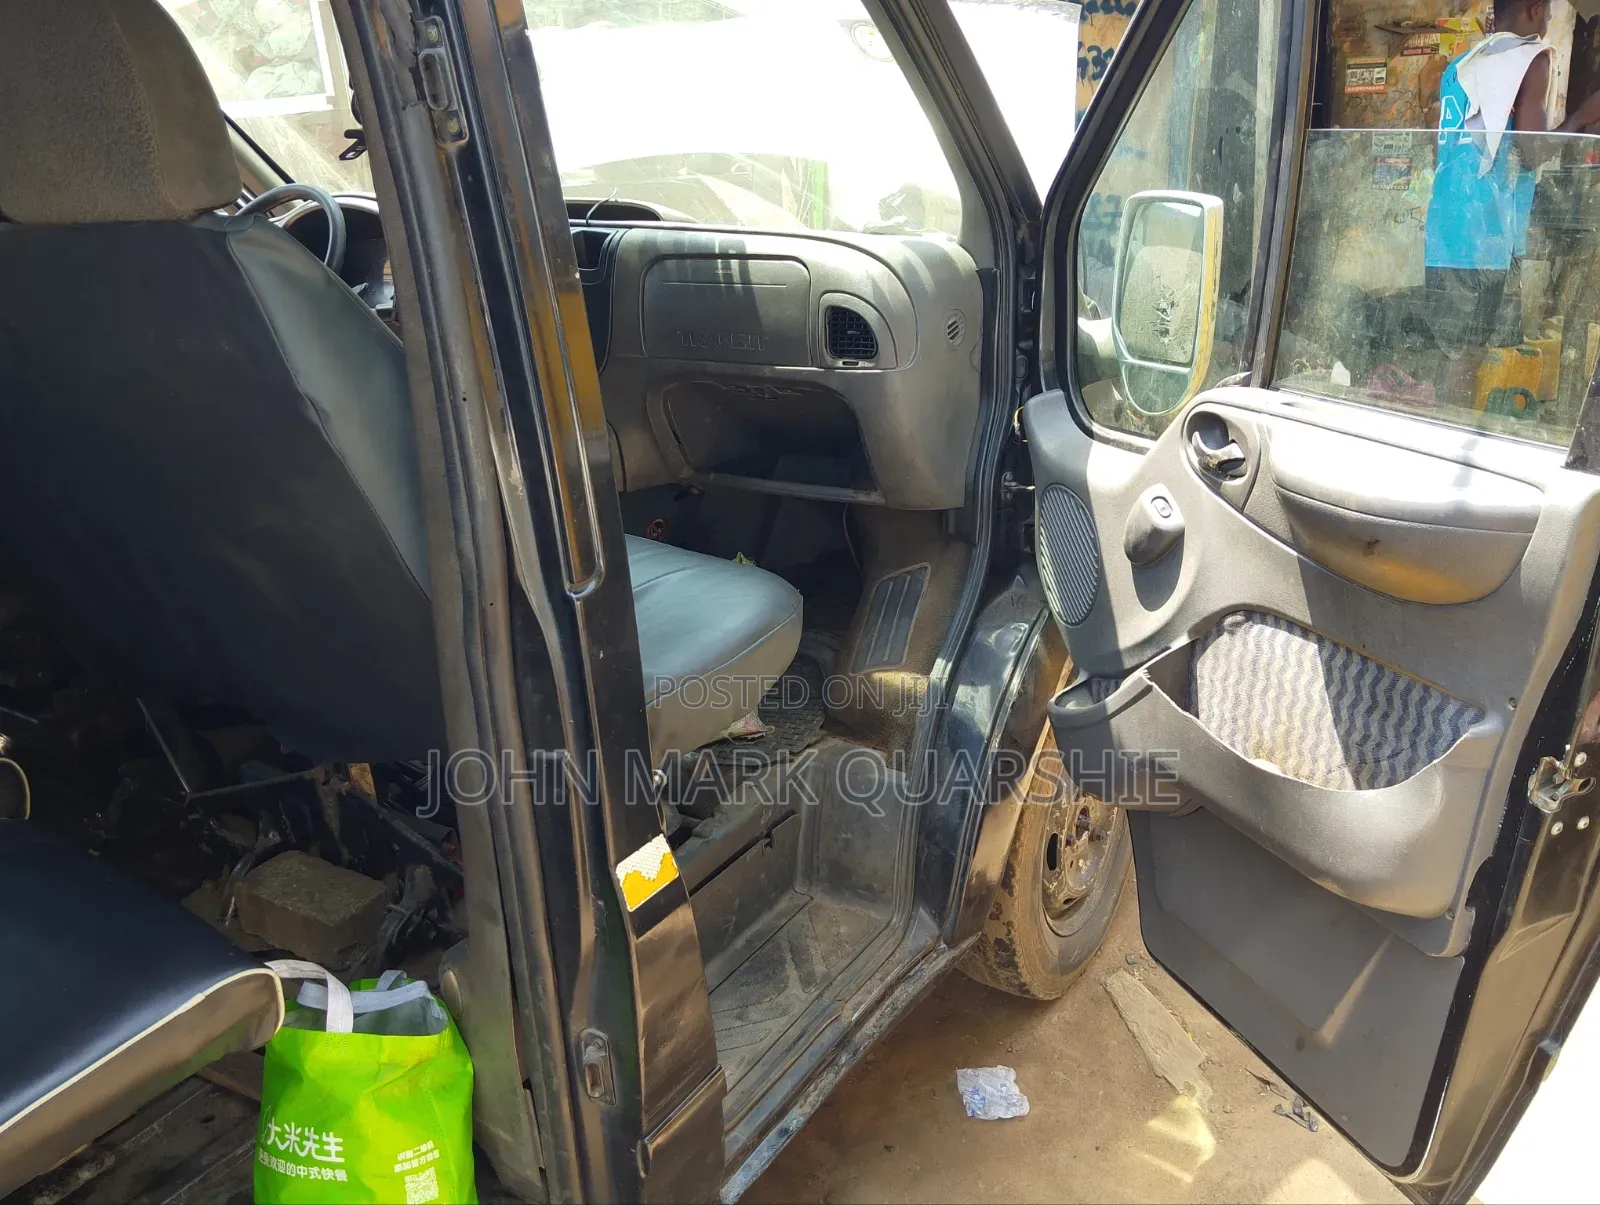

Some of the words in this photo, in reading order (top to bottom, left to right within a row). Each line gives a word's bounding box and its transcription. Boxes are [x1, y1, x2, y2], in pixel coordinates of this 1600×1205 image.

[676, 330, 770, 351] TRANSIT
[267, 1117, 345, 1163] 大米先生
